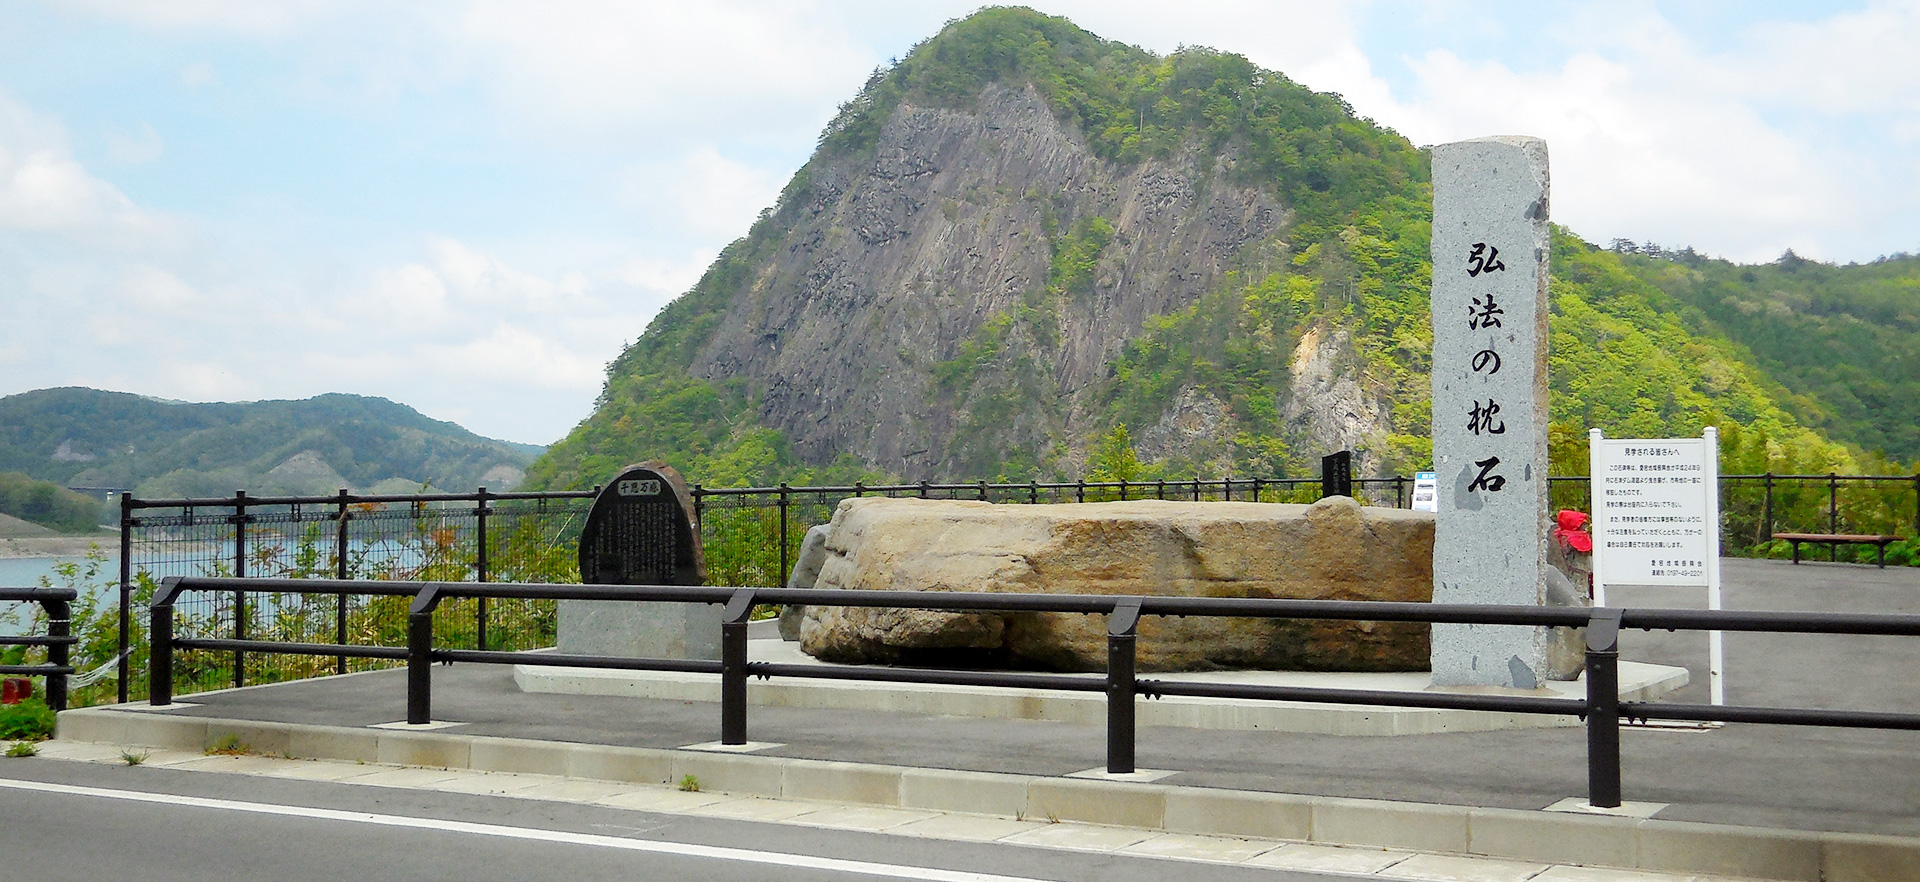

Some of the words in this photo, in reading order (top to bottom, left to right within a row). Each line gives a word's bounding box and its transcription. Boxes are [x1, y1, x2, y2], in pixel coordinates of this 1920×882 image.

[1466, 242, 1506, 493] 弘法の枕石
